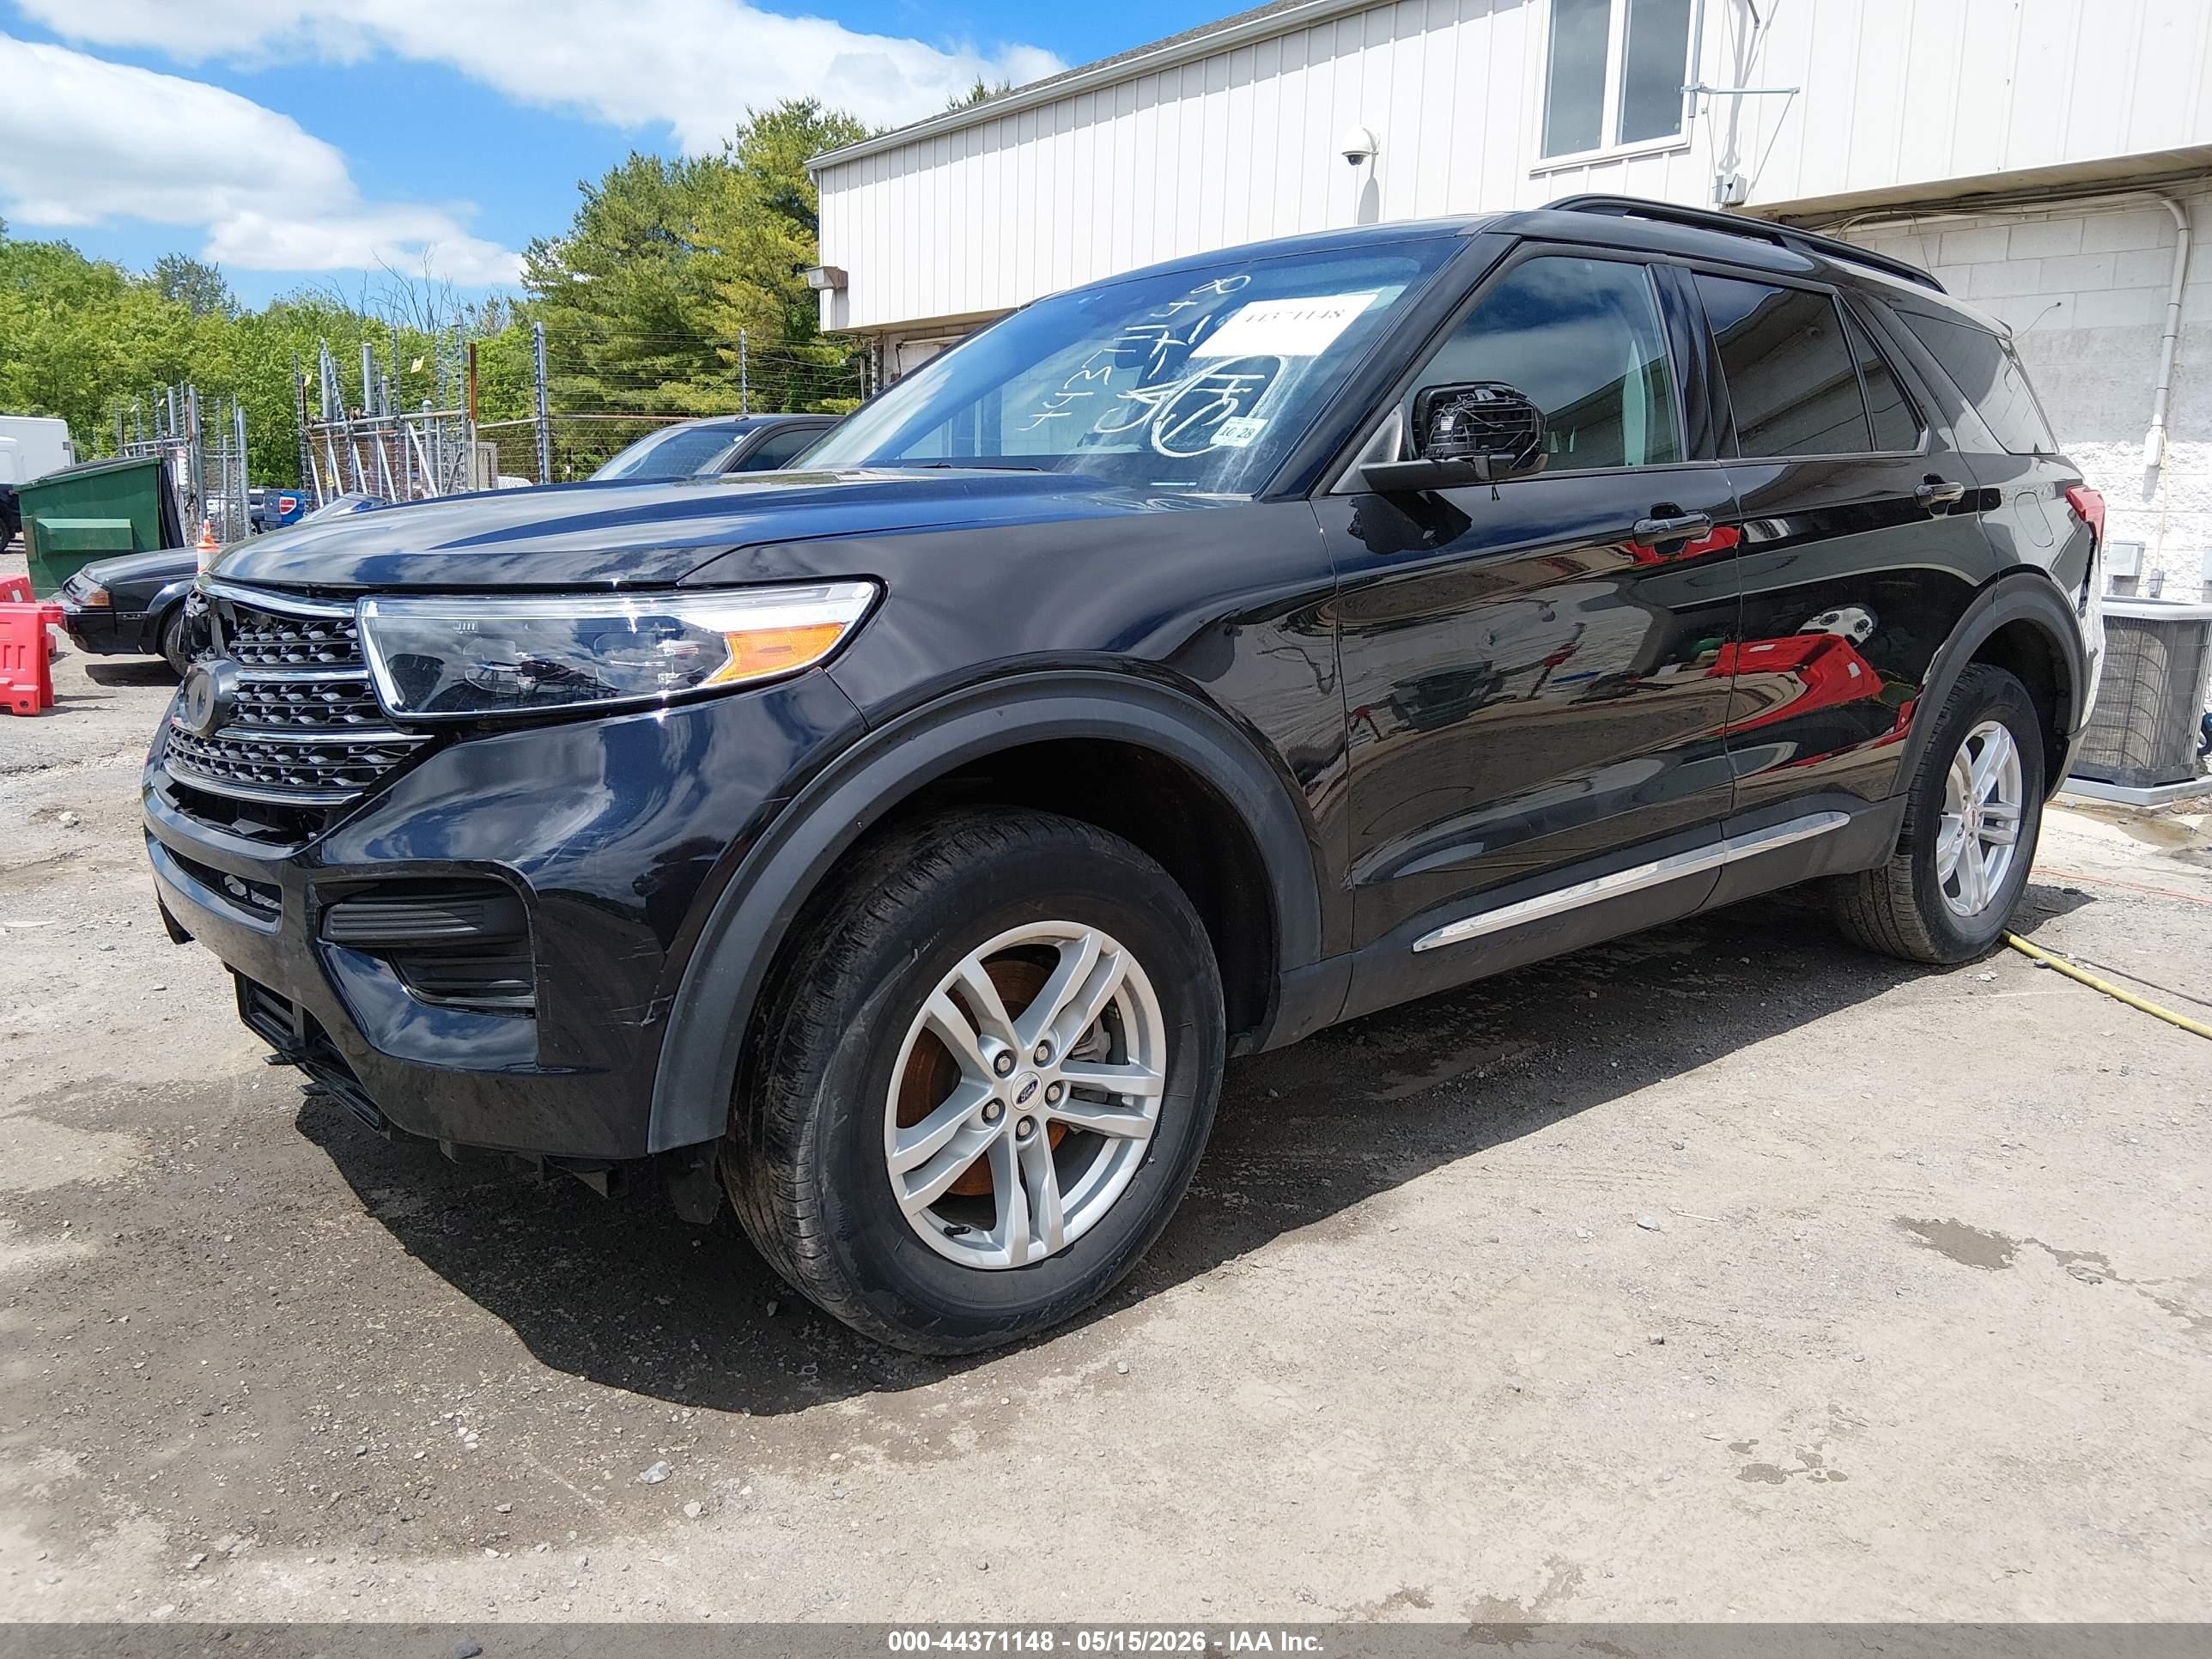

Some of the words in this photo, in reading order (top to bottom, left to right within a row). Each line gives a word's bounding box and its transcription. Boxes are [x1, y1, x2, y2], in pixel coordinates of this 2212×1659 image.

[1018, 275, 1252, 431] 44371148
[1219, 426, 1237, 437] 10
[1237, 427, 1255, 439] 28
